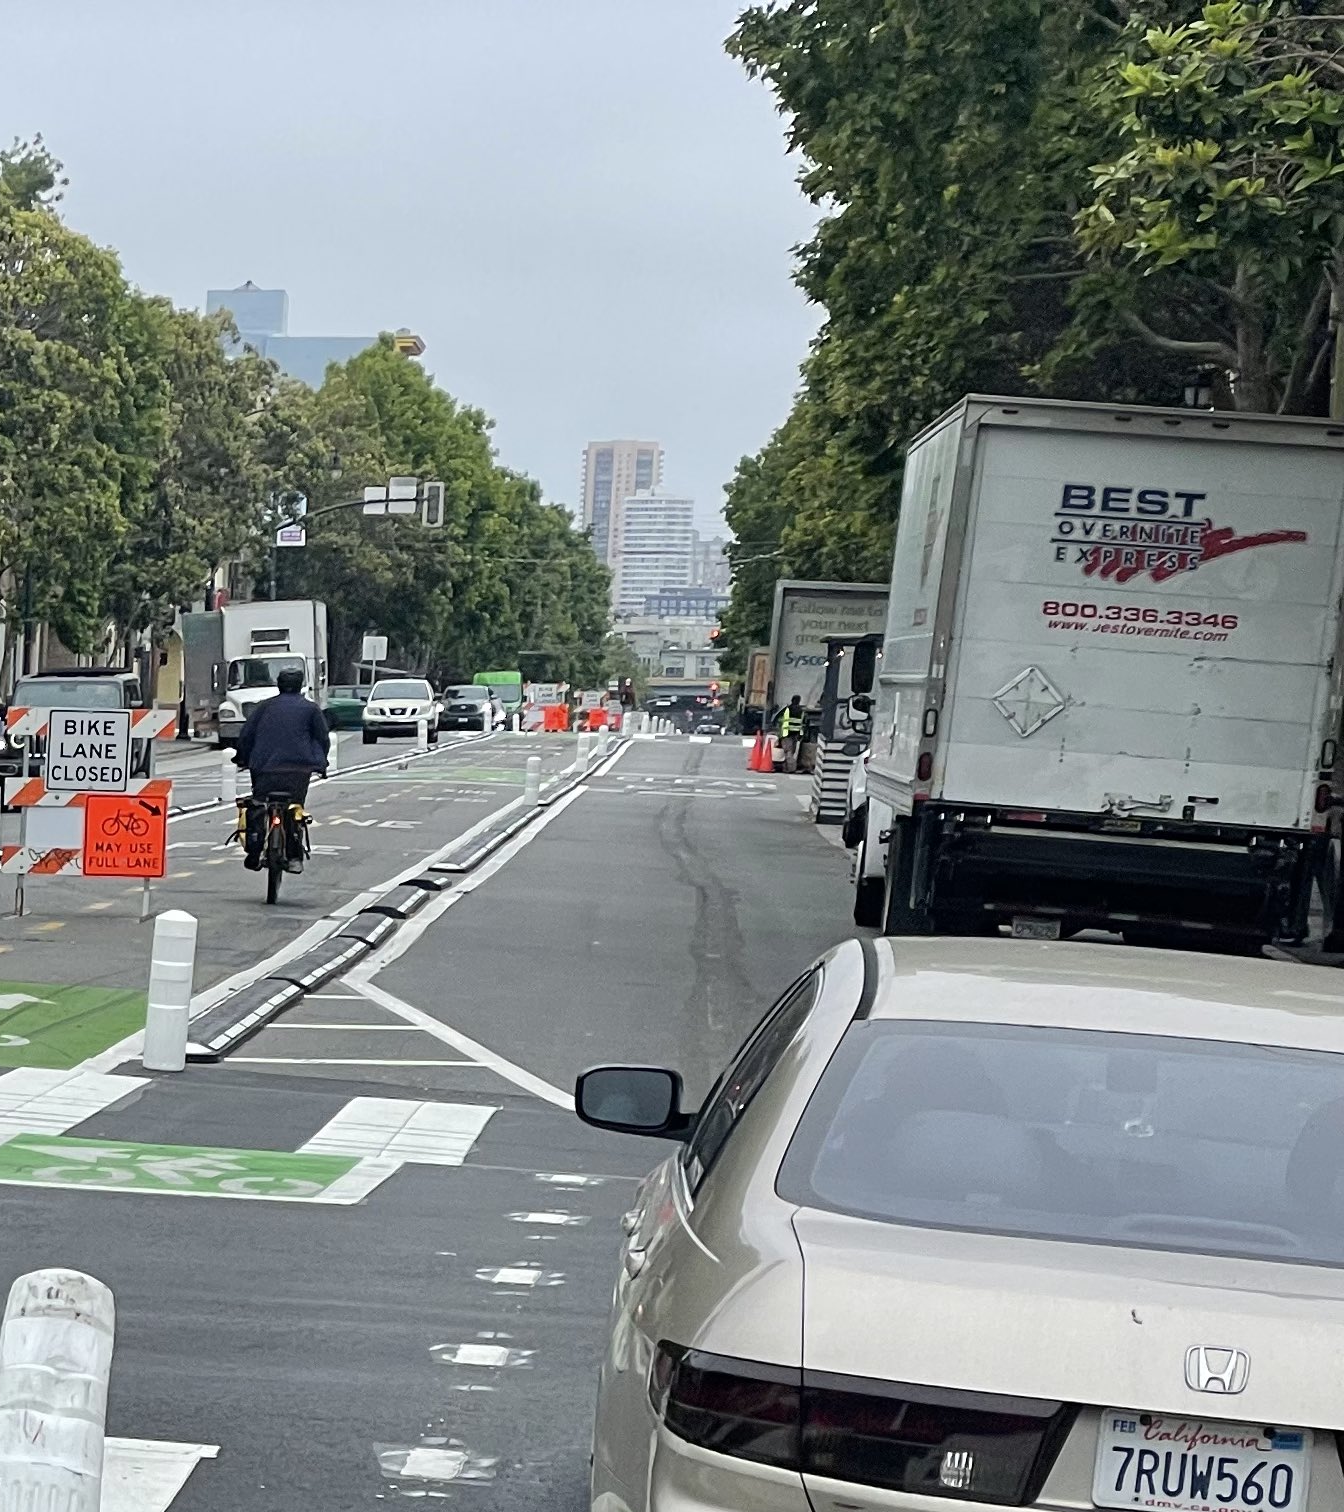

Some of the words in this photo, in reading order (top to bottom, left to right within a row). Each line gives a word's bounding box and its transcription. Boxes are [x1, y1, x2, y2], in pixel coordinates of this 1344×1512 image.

[1061, 484, 1208, 518] BEST
[1058, 520, 1200, 544] OVERNITE
[1055, 546, 1200, 571] EXPRESS
[1042, 601, 1239, 630] 800.336.3346
[64, 719, 116, 736] BIKE
[59, 742, 117, 759] LANE
[51, 765, 123, 782] CLOSED
[95, 842, 123, 852] MAY
[129, 842, 153, 854] USE
[88, 856, 119, 868] FULL
[126, 857, 159, 869] LANE
[1112, 1419, 1137, 1433] FEB
[1143, 1419, 1271, 1452] California
[1111, 1446, 1294, 1509] 7RUW560
